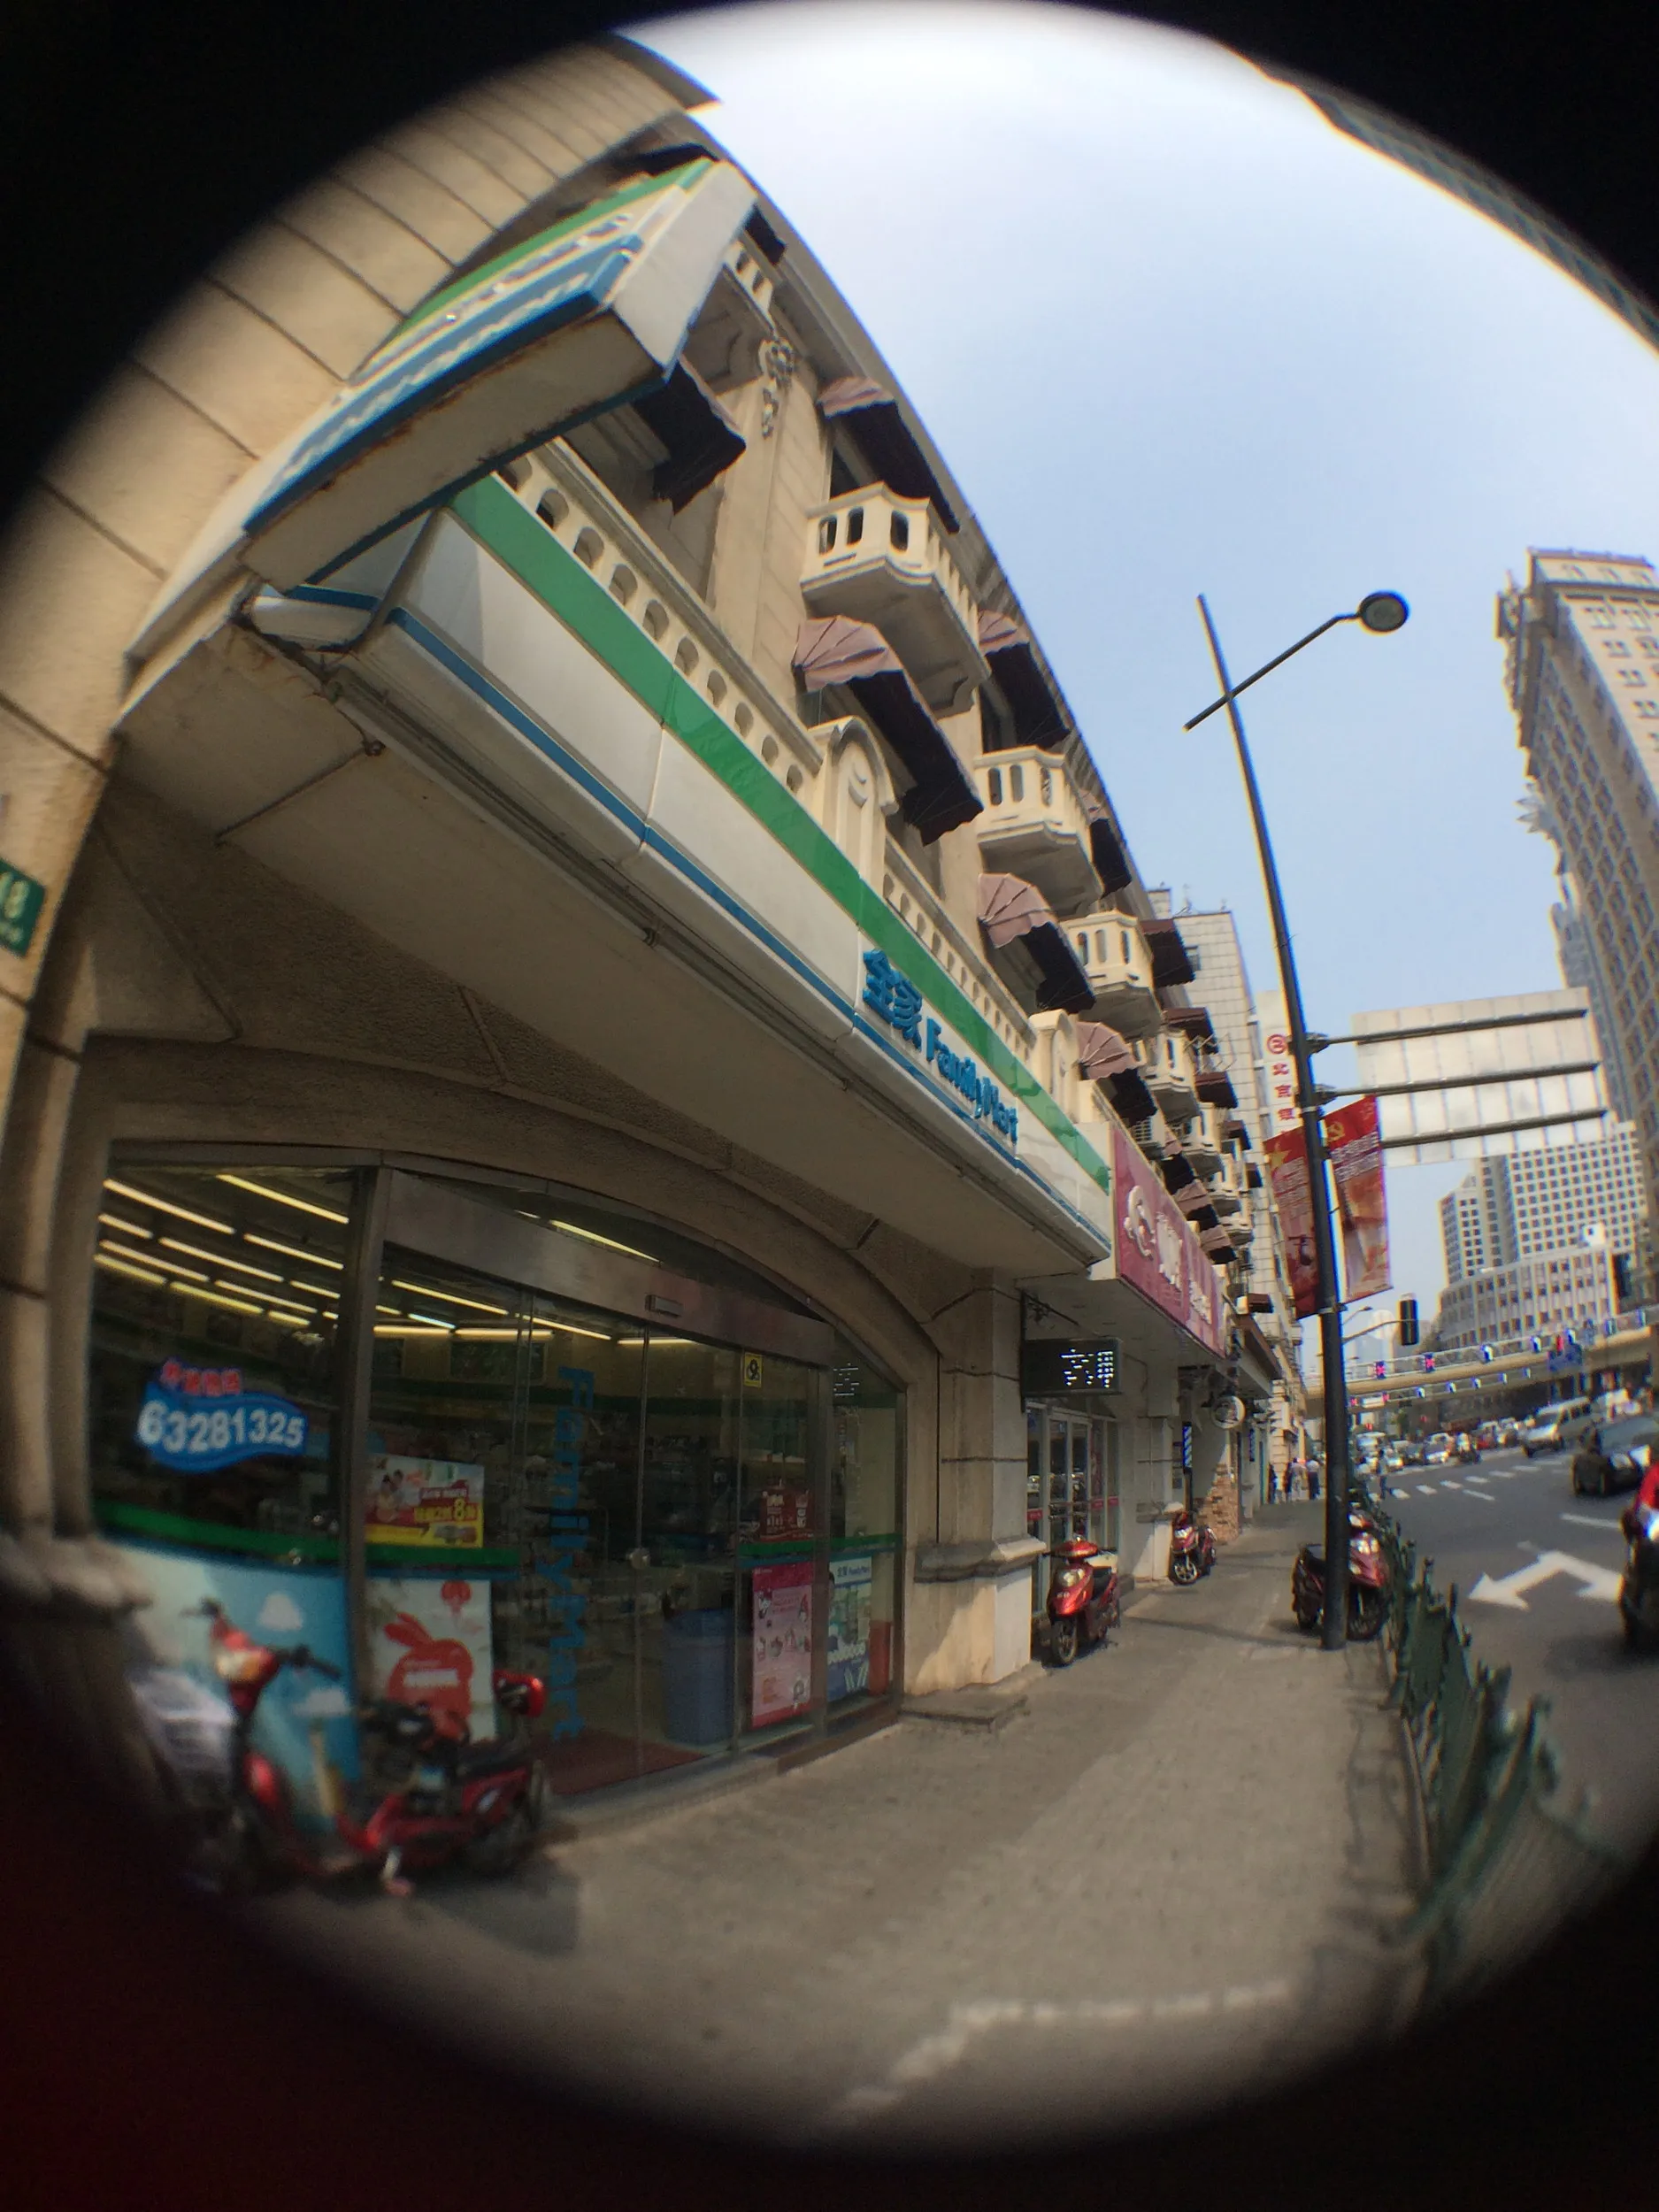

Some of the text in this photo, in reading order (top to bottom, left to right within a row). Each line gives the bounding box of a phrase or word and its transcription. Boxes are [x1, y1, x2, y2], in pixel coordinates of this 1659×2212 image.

[926, 1015, 1018, 1145] FamilyMart
[136, 1399, 307, 1454] 63281325
[534, 1366, 595, 1743] FamilyMart
